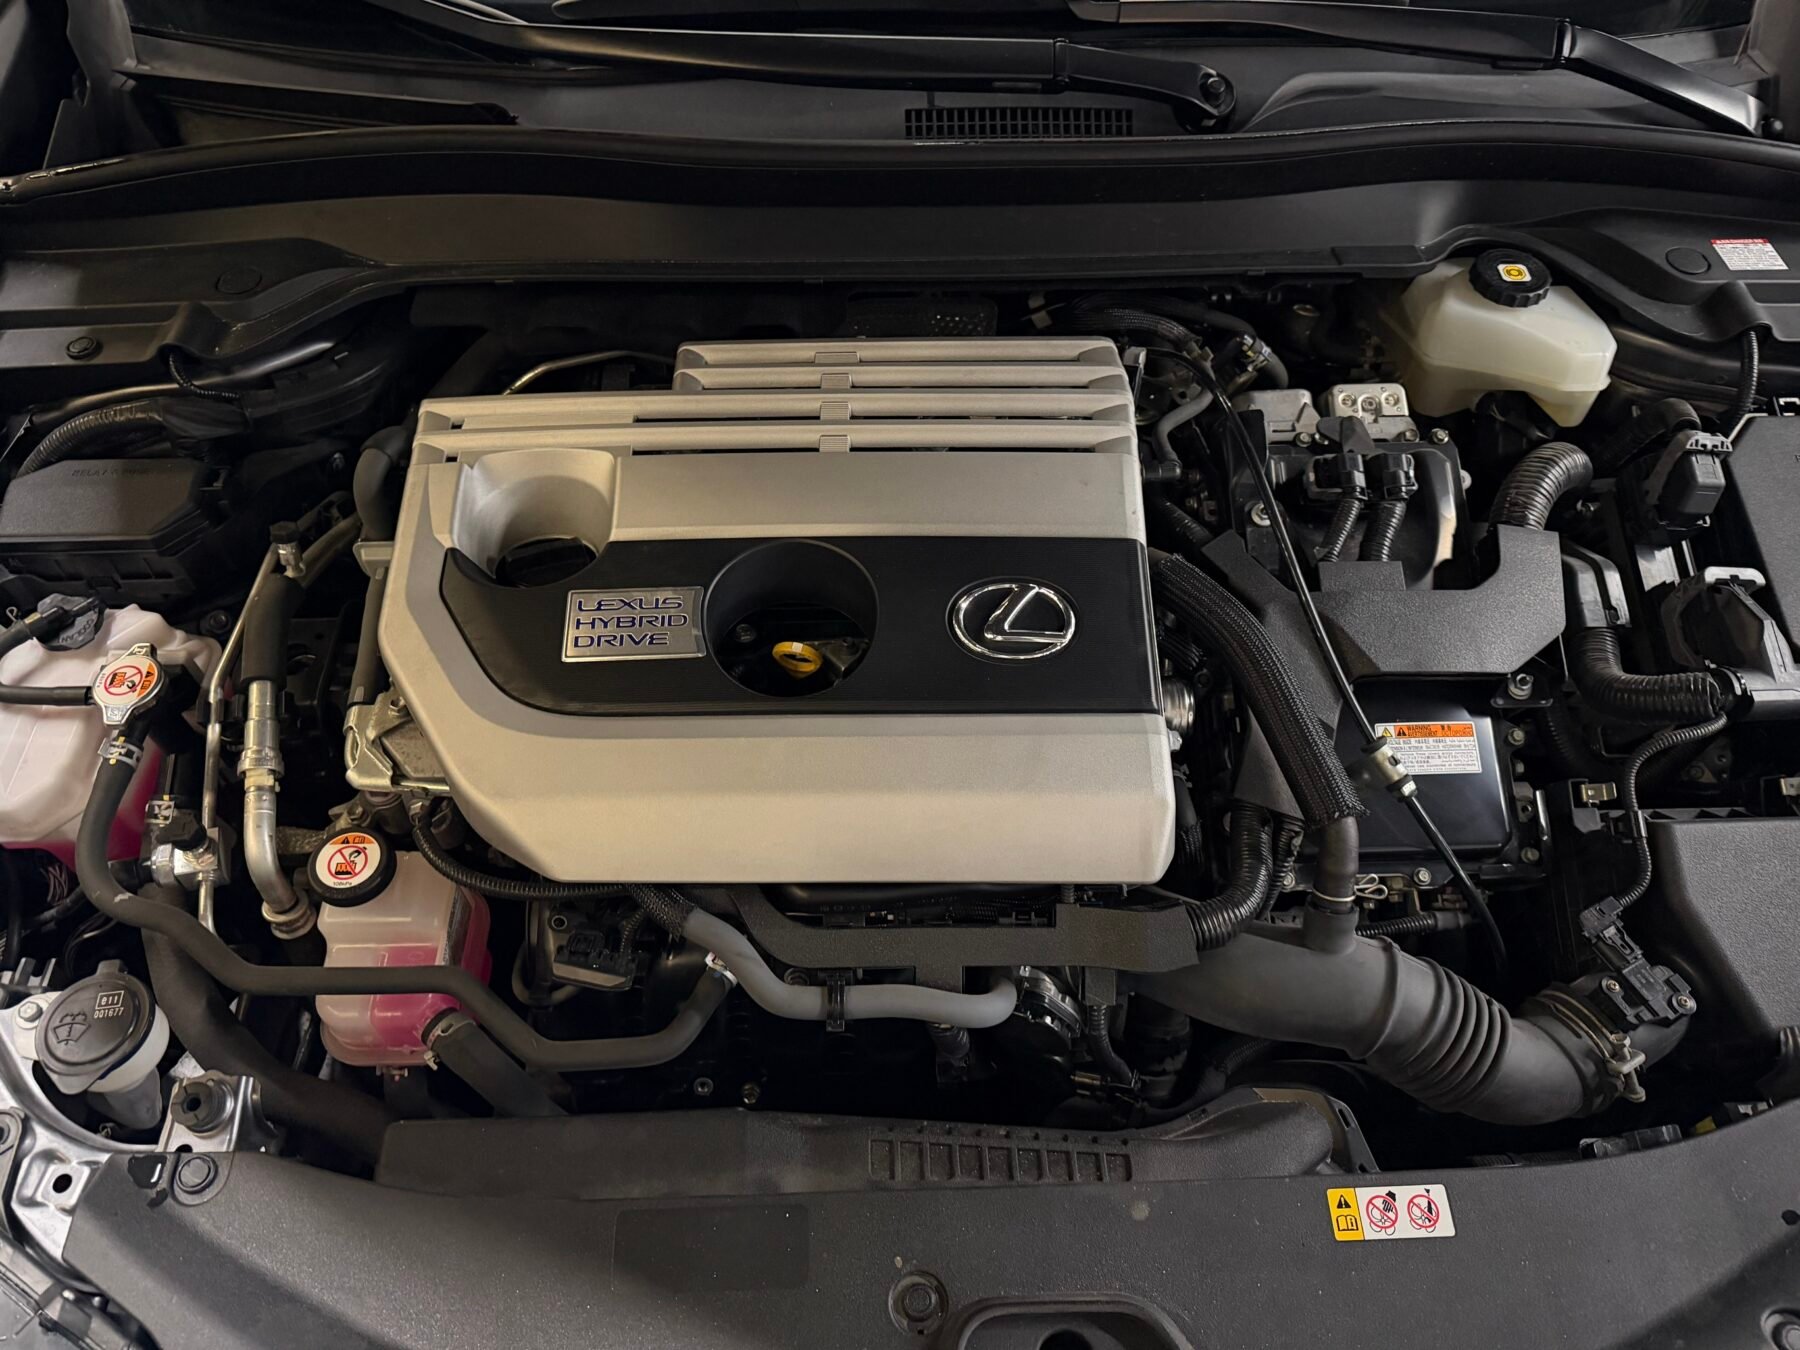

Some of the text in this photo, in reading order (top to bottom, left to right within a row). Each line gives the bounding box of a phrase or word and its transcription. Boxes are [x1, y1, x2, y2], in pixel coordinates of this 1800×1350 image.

[577, 596, 683, 612] LEXUS
[575, 613, 689, 630] HYBRID
[573, 632, 669, 648] DRIVE
[94, 1008, 124, 1018] 001677
